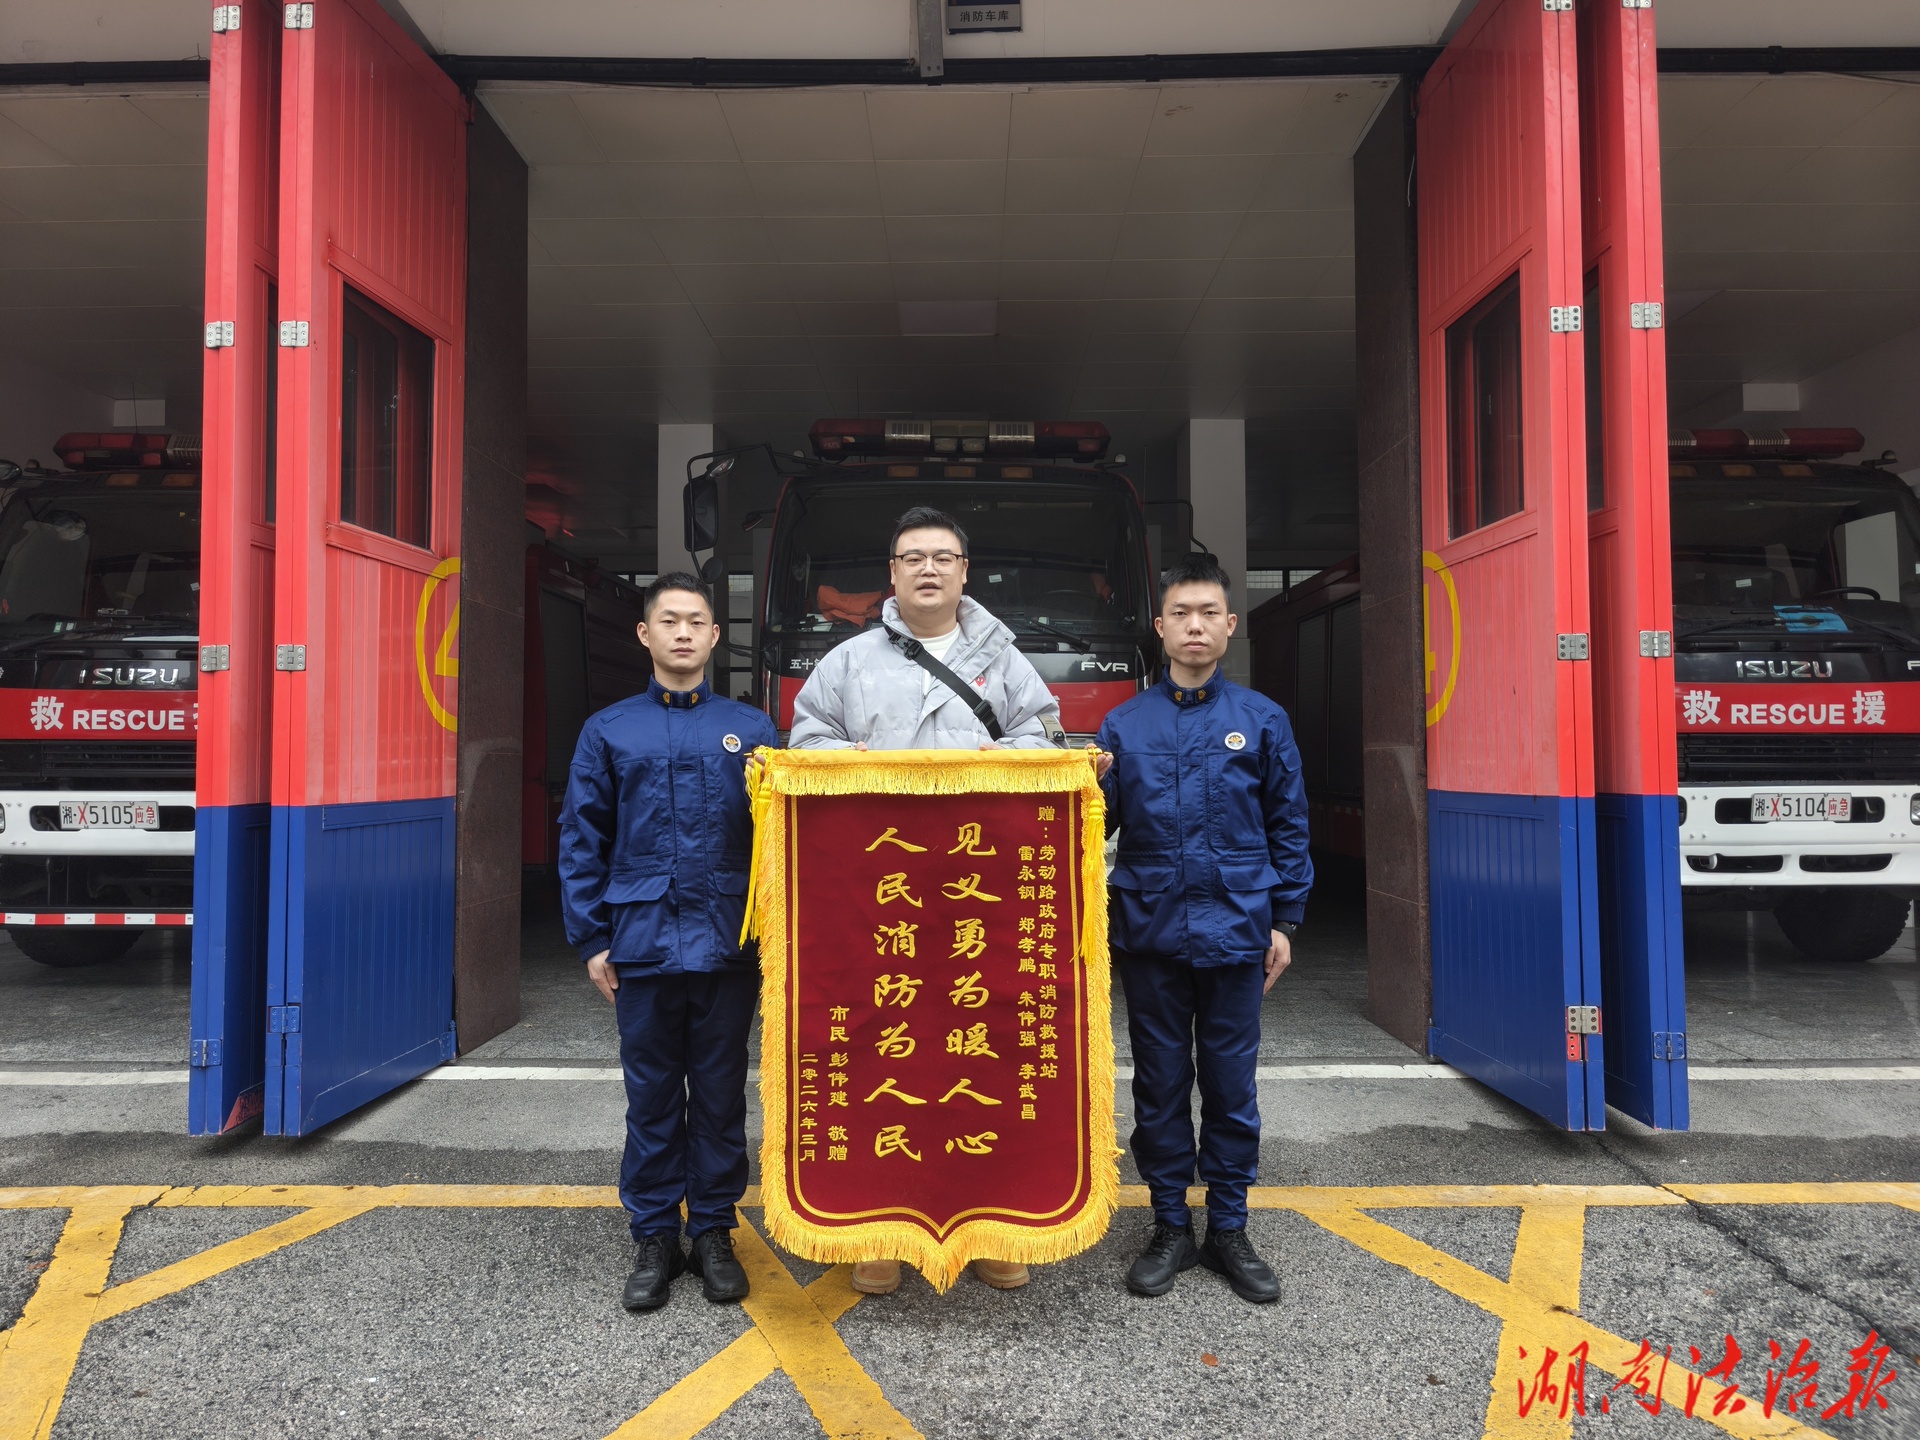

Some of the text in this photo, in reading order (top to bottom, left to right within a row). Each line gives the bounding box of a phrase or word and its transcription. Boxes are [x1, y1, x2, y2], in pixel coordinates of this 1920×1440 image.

[959, 9, 1009, 22] 消防车库
[79, 667, 179, 686] ISUZU
[1080, 661, 1129, 673] FVR
[1736, 660, 1833, 678] ISUZU
[30, 695, 65, 731] 救
[72, 709, 185, 731] RESCUE
[1682, 689, 1887, 726] 救 RESCUE 援
[863, 827, 929, 1162] 人民消防为人民
[937, 822, 1003, 1156] 见义勇为暖人心
[1016, 845, 1038, 1121] 雷永钢 郑孝鹏 朱伟强 李武昌
[827, 1005, 850, 1161] 市民 彭伟建 敬赠
[799, 1053, 819, 1162] 二零二六年三月
